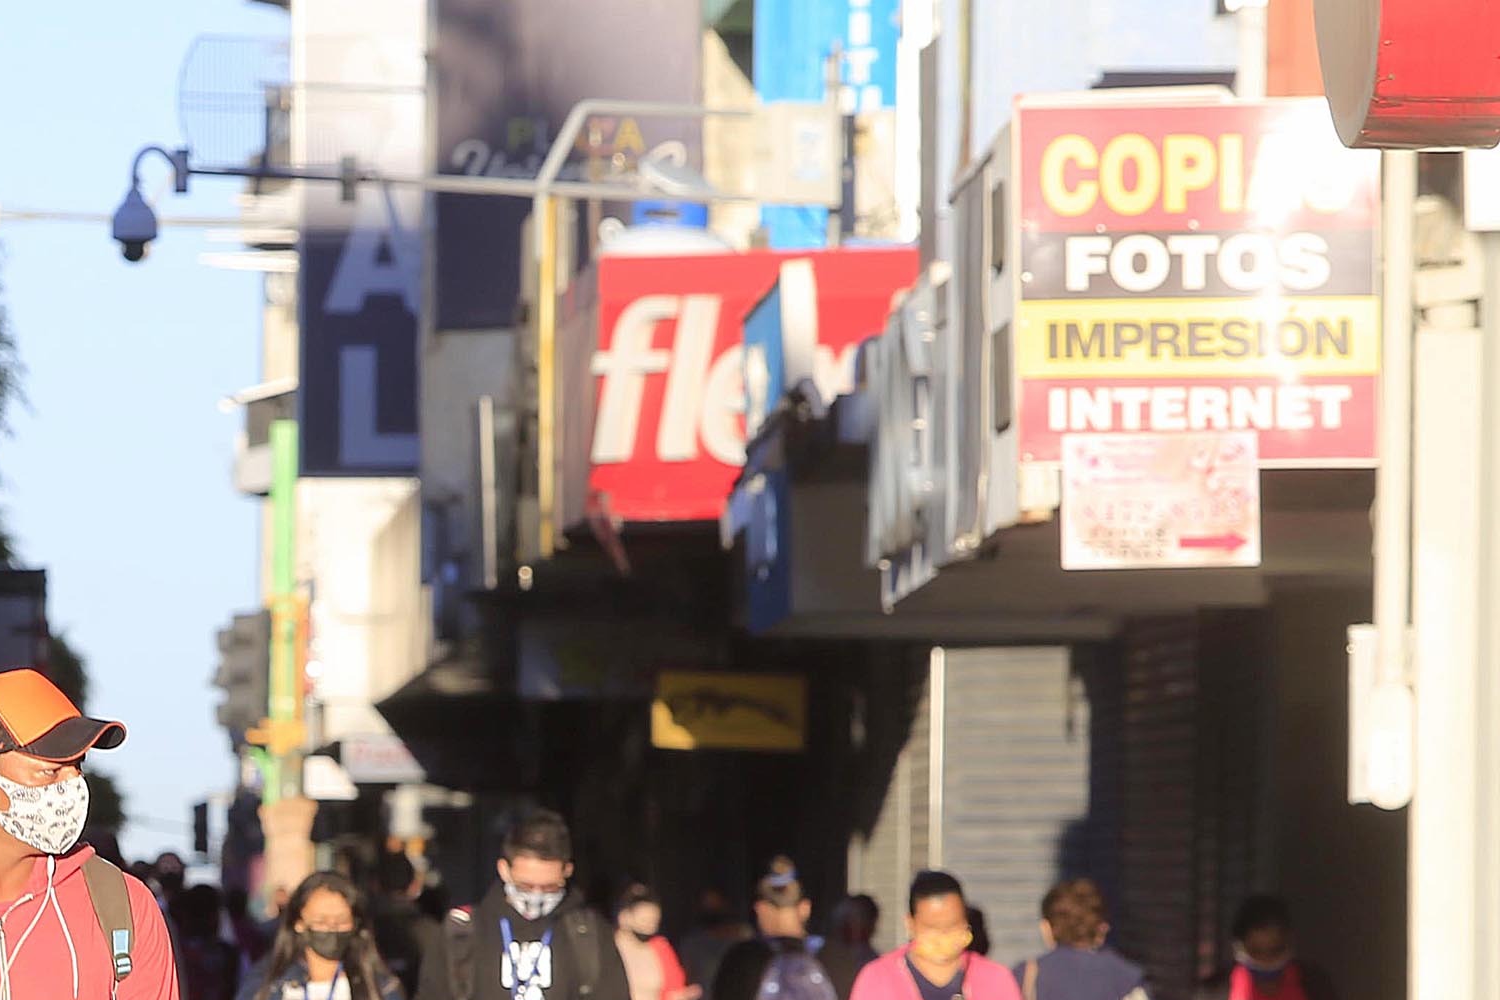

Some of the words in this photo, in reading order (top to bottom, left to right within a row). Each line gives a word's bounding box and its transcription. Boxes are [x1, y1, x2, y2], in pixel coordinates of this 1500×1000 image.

[1040, 133, 1350, 216] COPI
[1065, 232, 1332, 292] FOTOS
[1048, 306, 1350, 360] IMPRESIÓN
[1048, 385, 1353, 432] INTERNET
